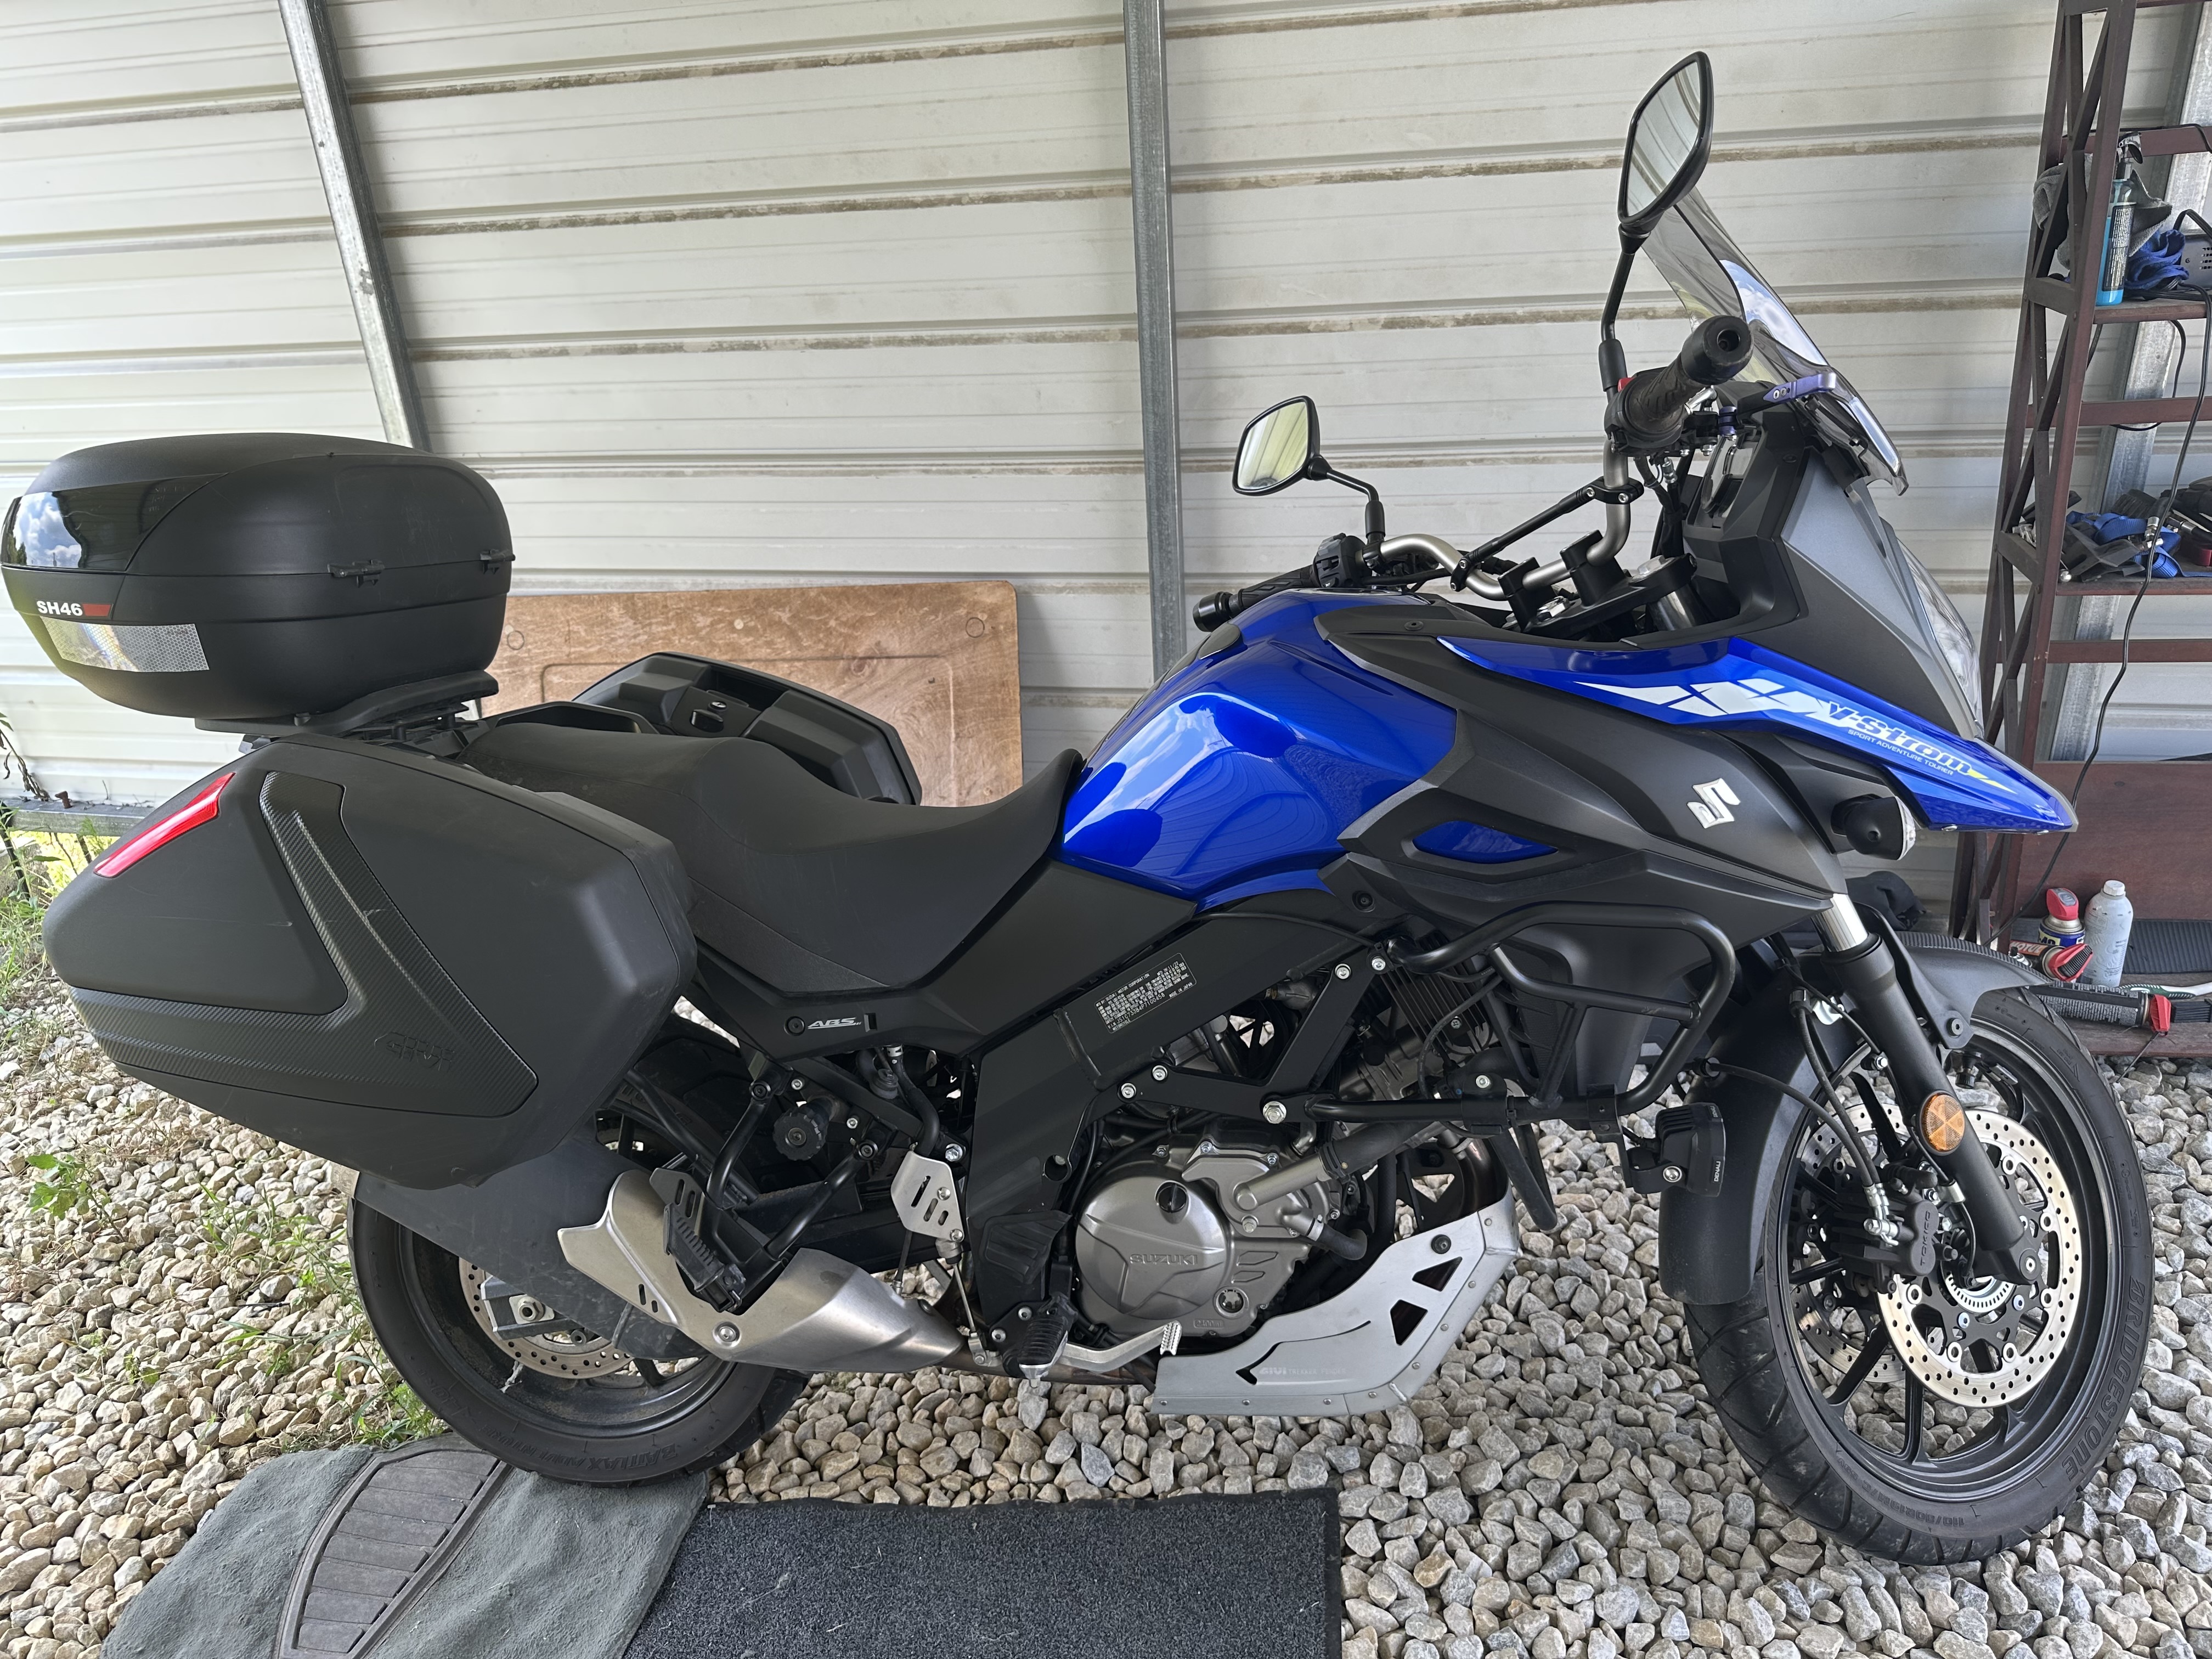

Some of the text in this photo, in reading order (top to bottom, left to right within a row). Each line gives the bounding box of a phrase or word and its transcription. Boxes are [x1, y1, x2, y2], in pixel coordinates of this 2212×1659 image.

[37, 601, 83, 616] SH46
[1848, 729, 1953, 775] SPORT ADVENTURE TOURER
[1182, 981, 1192, 990] JAPAN
[808, 1017, 856, 1029] ABS
[1919, 1209, 1931, 1266] TOKICO
[1130, 1254, 1198, 1265] SUZUKI
[2062, 1275, 2147, 1481] BRIDGESTONE
[479, 1424, 586, 1469] ADVENTURE
[585, 1442, 678, 1471] BATTLAX
